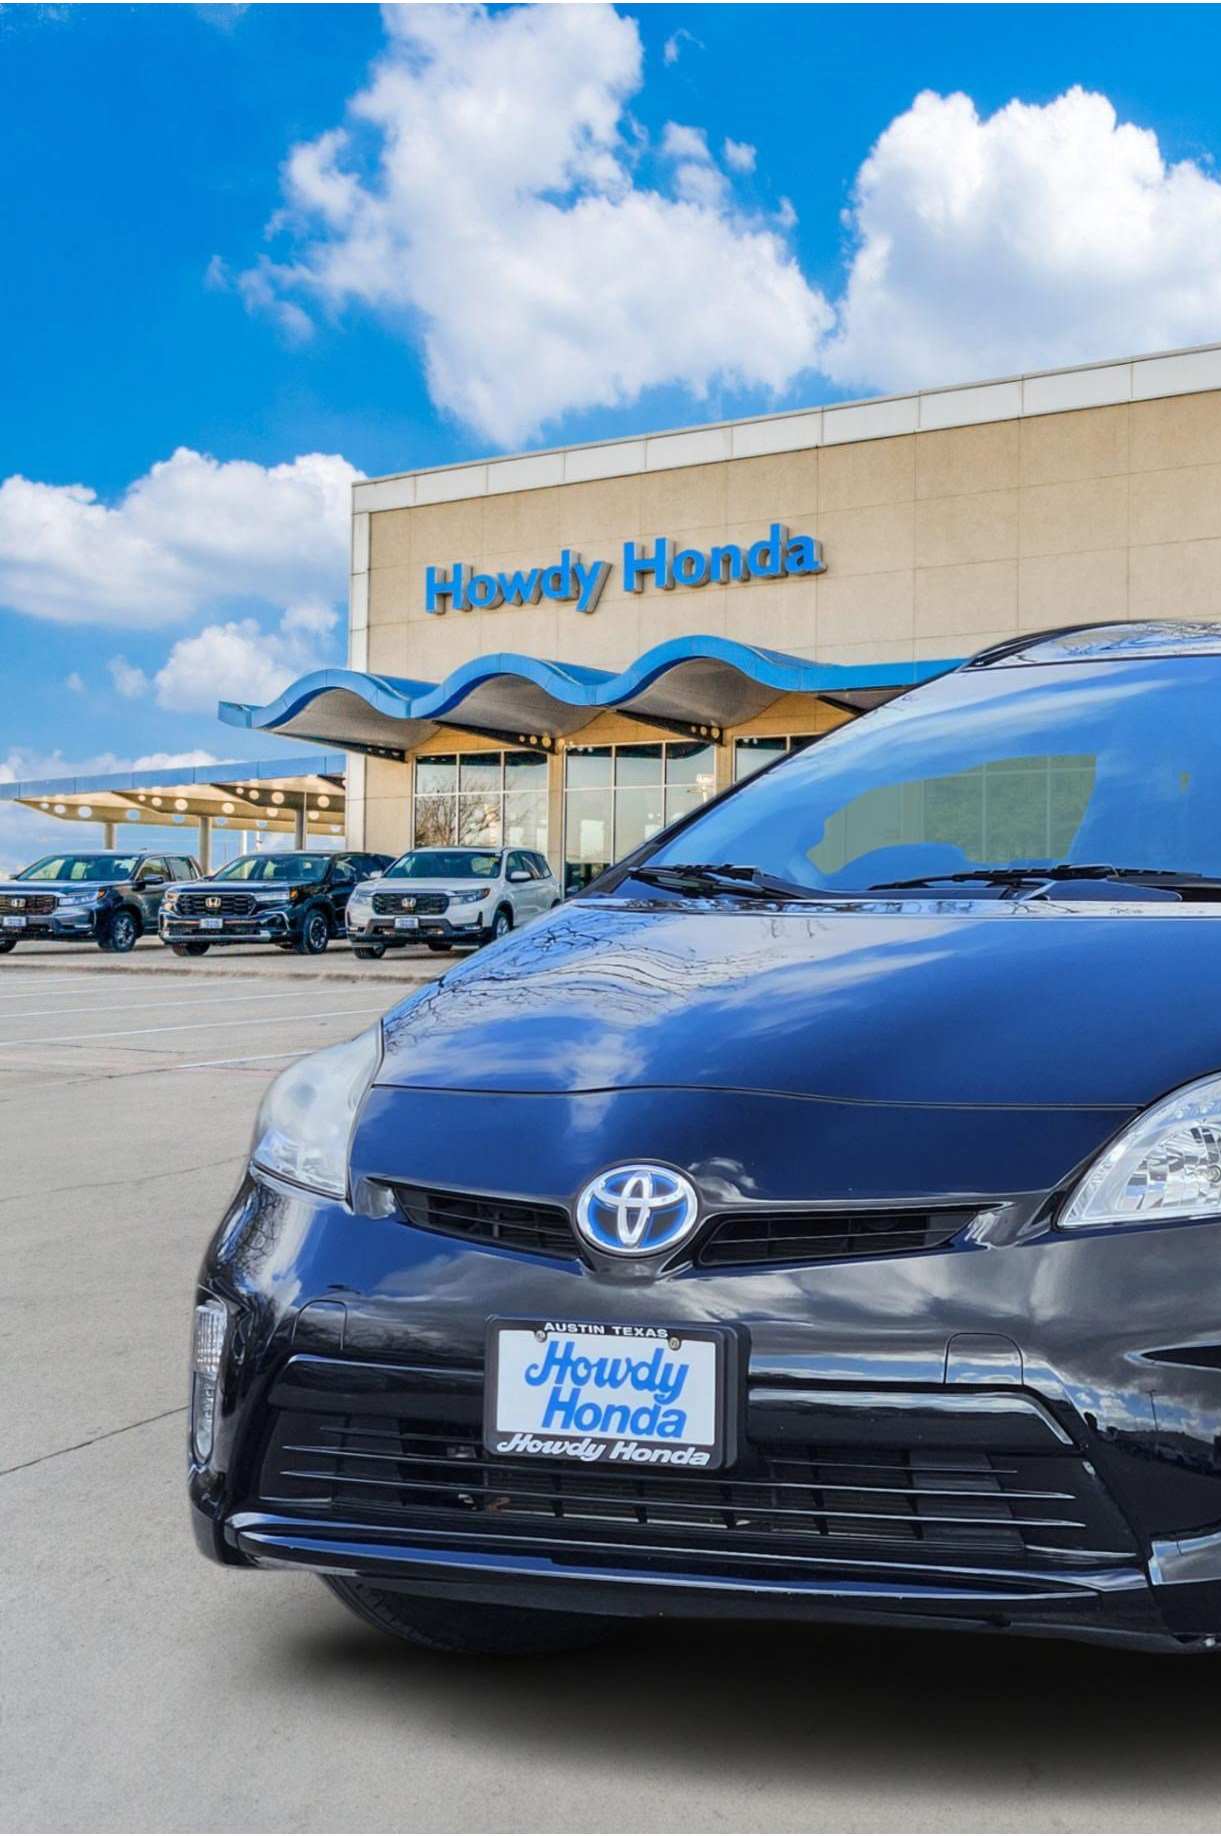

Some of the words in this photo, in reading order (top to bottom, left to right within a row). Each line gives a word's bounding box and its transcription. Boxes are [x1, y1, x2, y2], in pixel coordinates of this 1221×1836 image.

[424, 549, 612, 615] Howdy
[622, 523, 827, 593] Honda
[543, 1321, 605, 1335] AUSTIN
[611, 1325, 669, 1339] TEXAS
[524, 1341, 690, 1405] Howdy
[541, 1386, 688, 1438] Honda
[496, 1433, 607, 1462] Howdy
[609, 1441, 712, 1467] Honda
